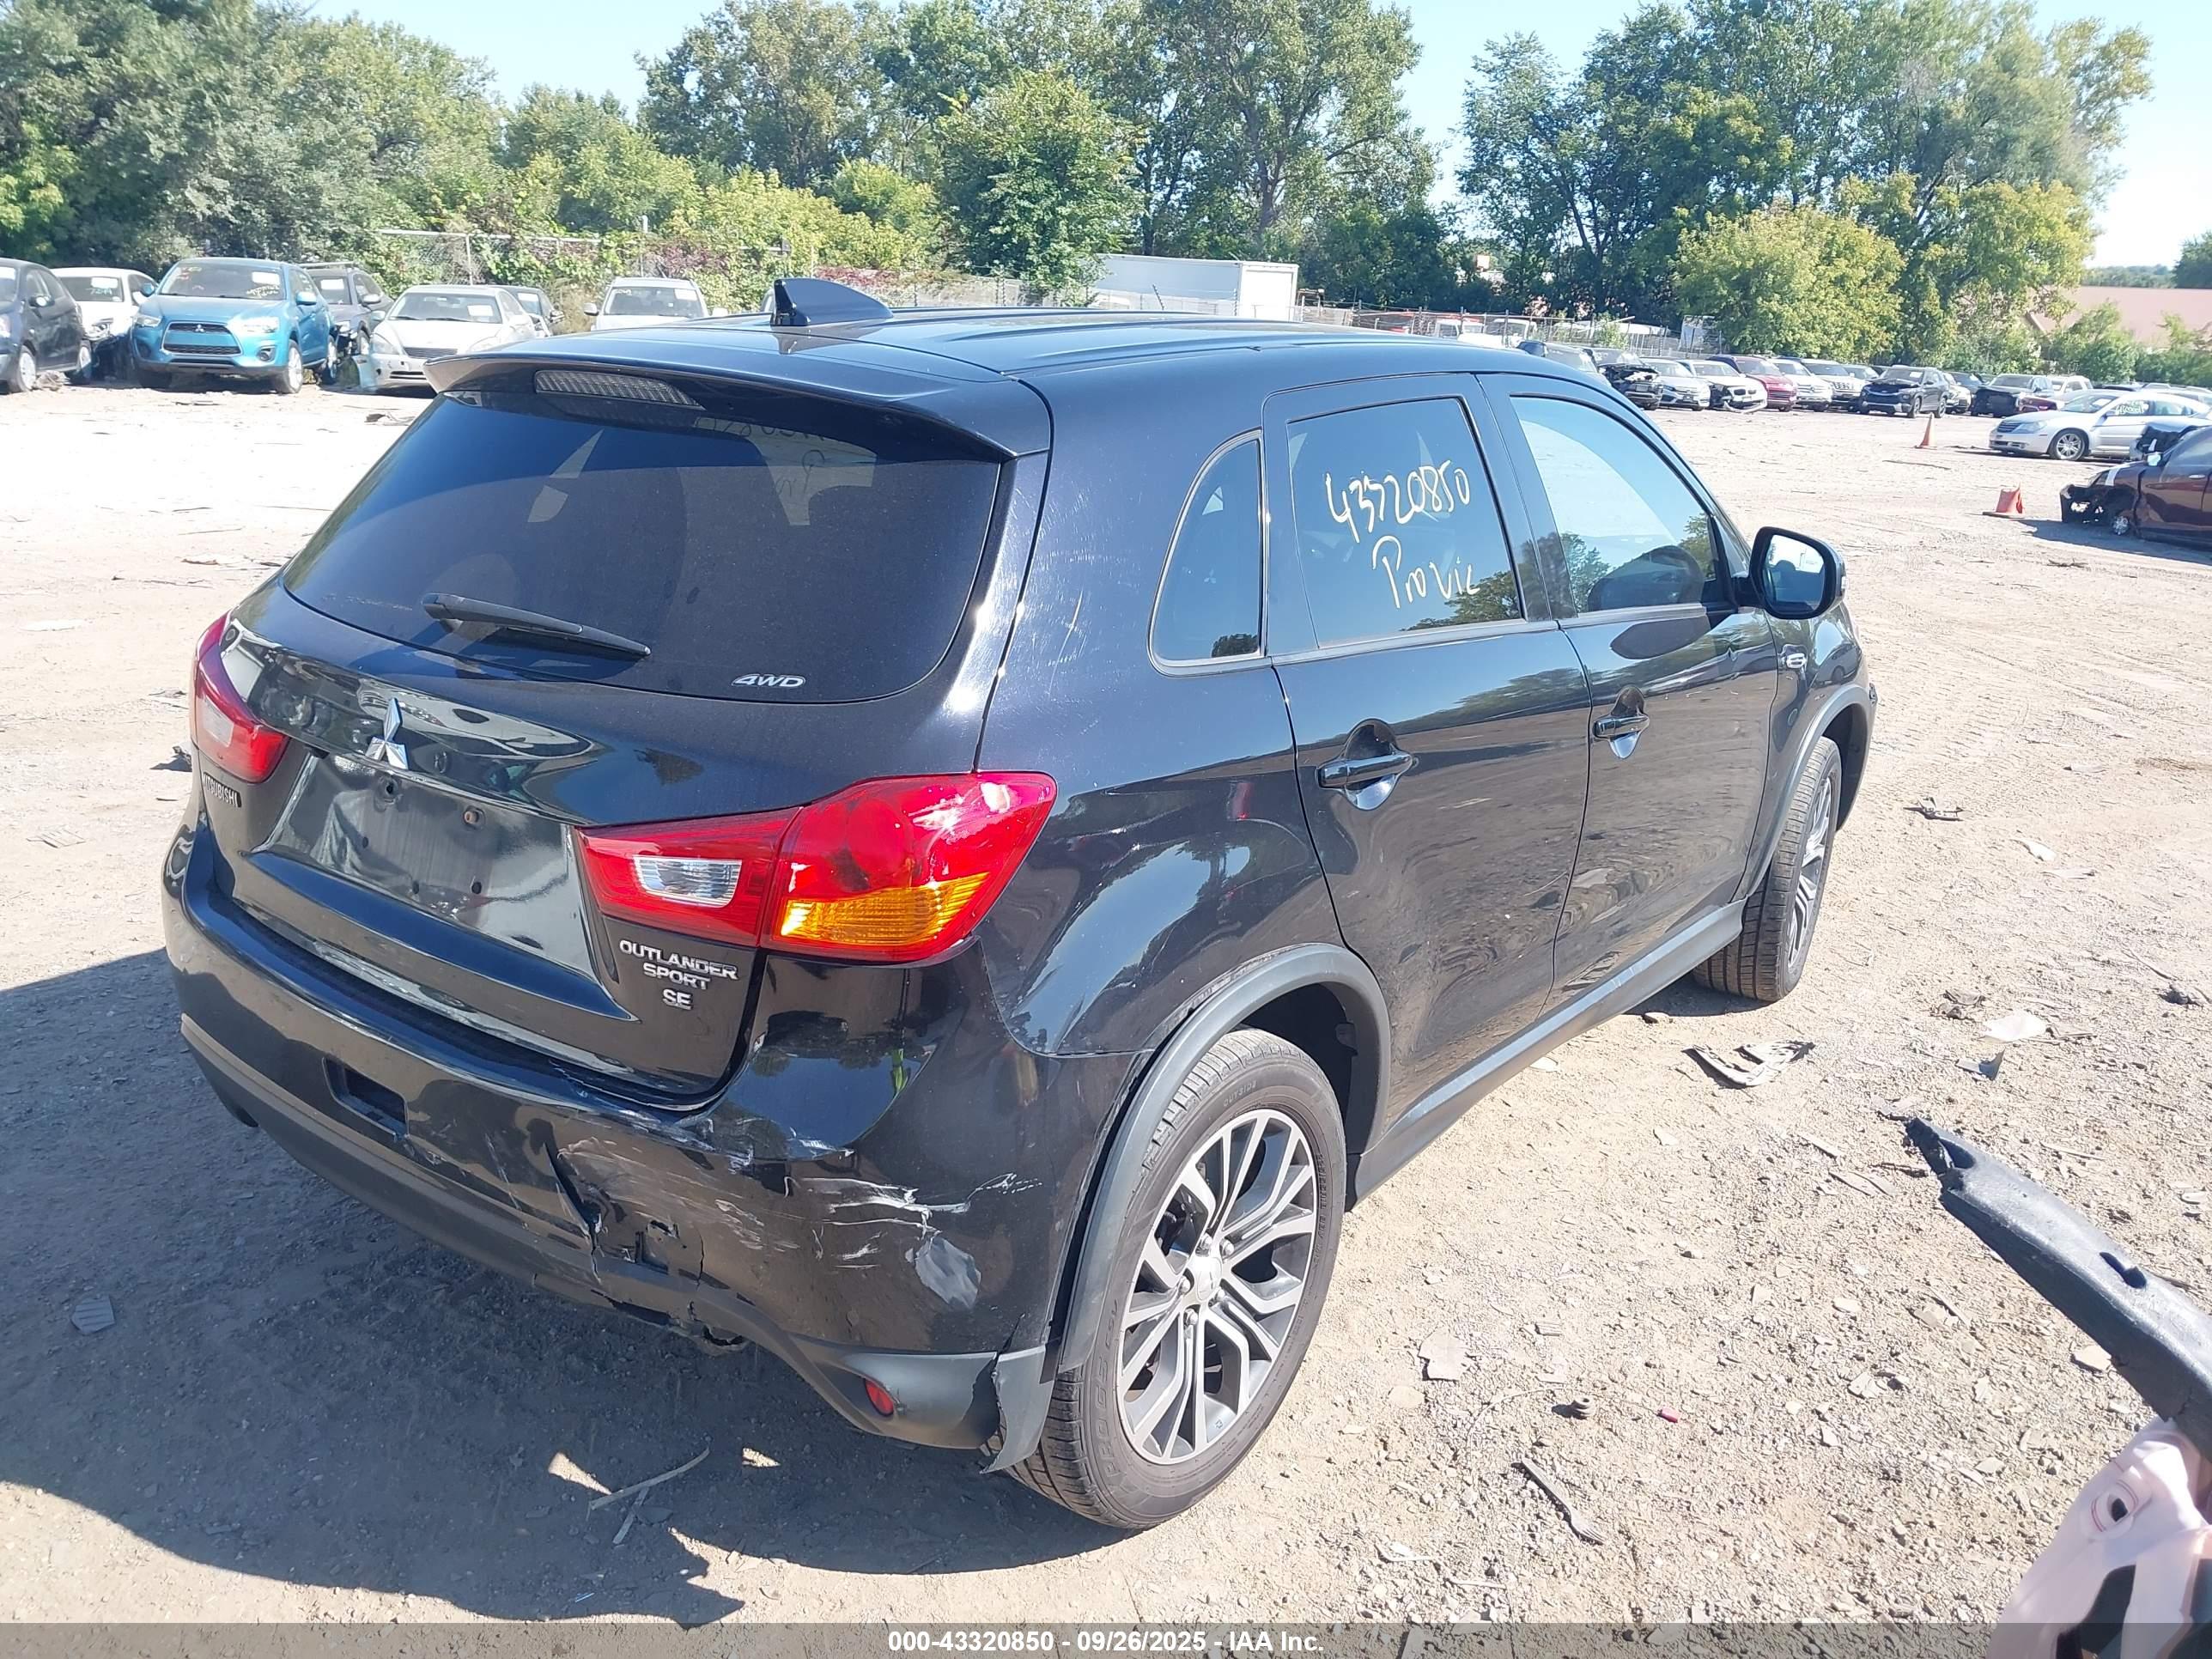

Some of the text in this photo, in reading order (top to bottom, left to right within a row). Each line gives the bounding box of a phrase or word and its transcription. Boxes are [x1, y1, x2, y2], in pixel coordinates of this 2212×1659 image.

[732, 673, 805, 688] 4WD
[202, 772, 240, 808] MITSUBISHI
[619, 939, 739, 980] OUTLANDER
[643, 963, 711, 989] SPORT
[662, 988, 692, 1011] SE
